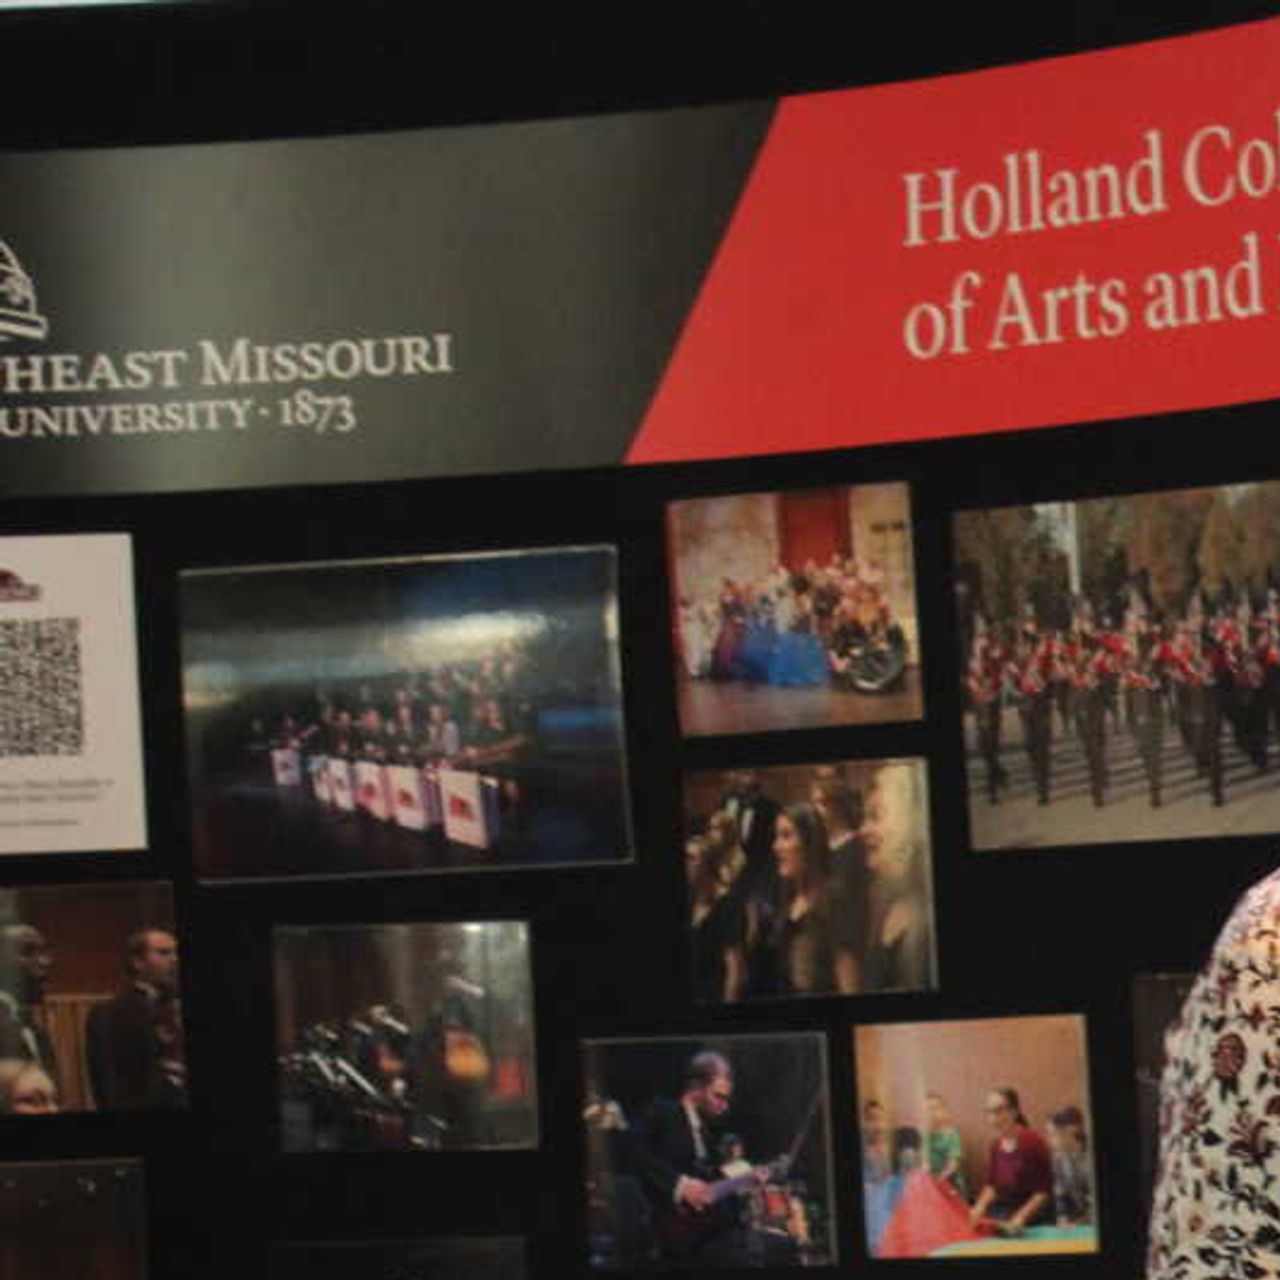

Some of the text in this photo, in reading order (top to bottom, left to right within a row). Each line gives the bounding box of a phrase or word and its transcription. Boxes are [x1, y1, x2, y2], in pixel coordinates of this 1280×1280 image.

[903, 129, 1168, 247] Holland
[903, 270, 983, 361] of
[989, 271, 1130, 351] Arts
[1143, 230, 1266, 330] and
[0, 388, 357, 438] UNIVERSITY 1873
